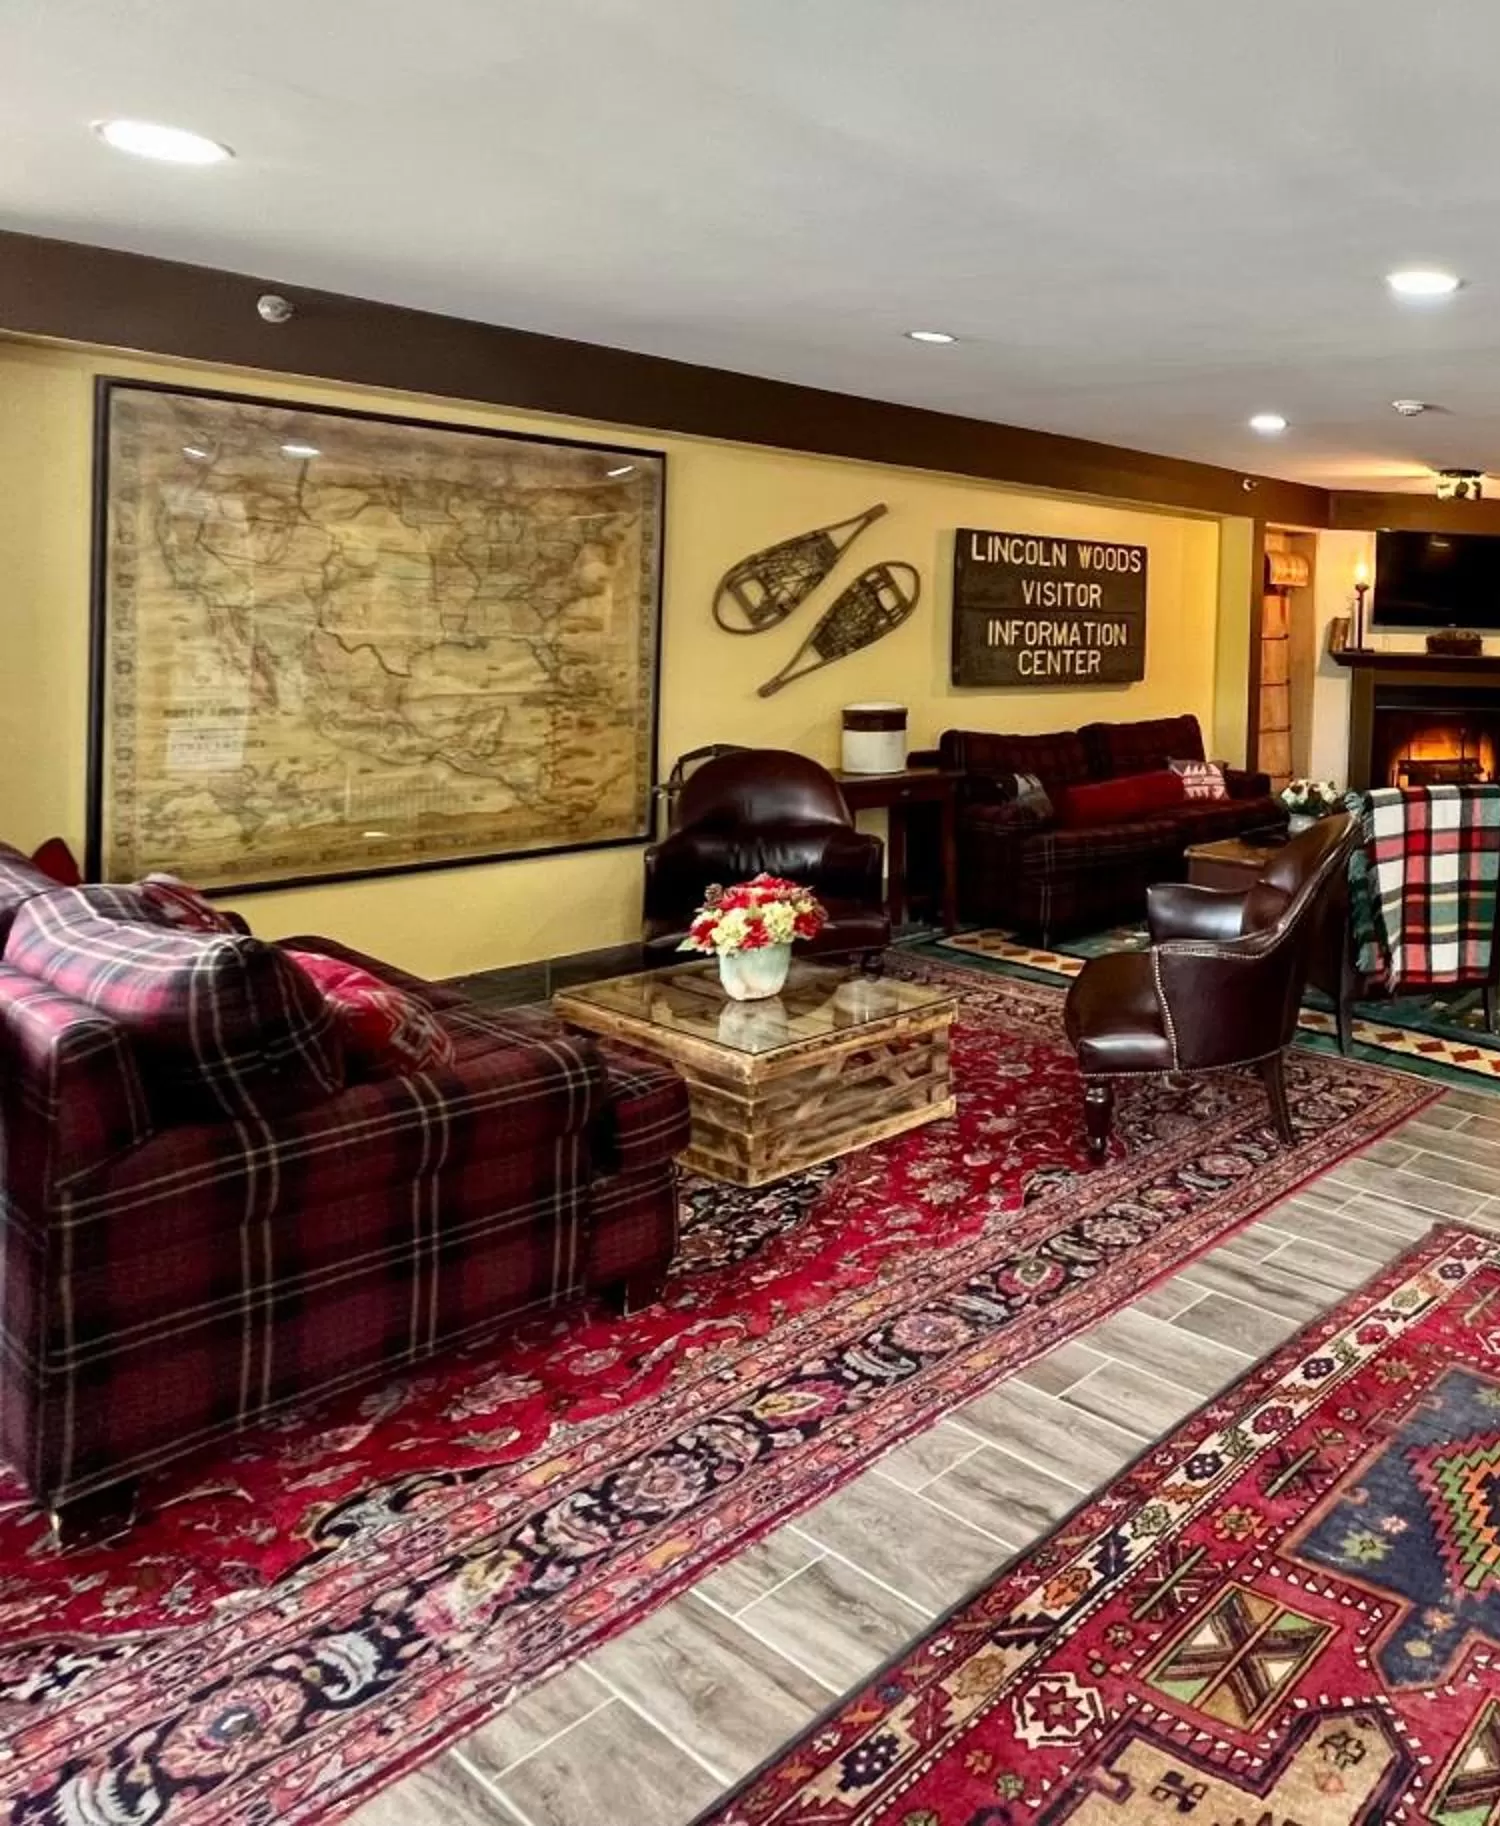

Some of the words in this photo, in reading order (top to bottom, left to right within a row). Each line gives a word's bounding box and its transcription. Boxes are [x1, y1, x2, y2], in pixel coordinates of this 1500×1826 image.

[970, 533, 1067, 567] LINCOLN
[1077, 543, 1142, 573] WOODS
[1021, 579, 1102, 608] VISITOR
[986, 619, 1127, 646] INFORMATION
[1017, 649, 1101, 676] CENTER
